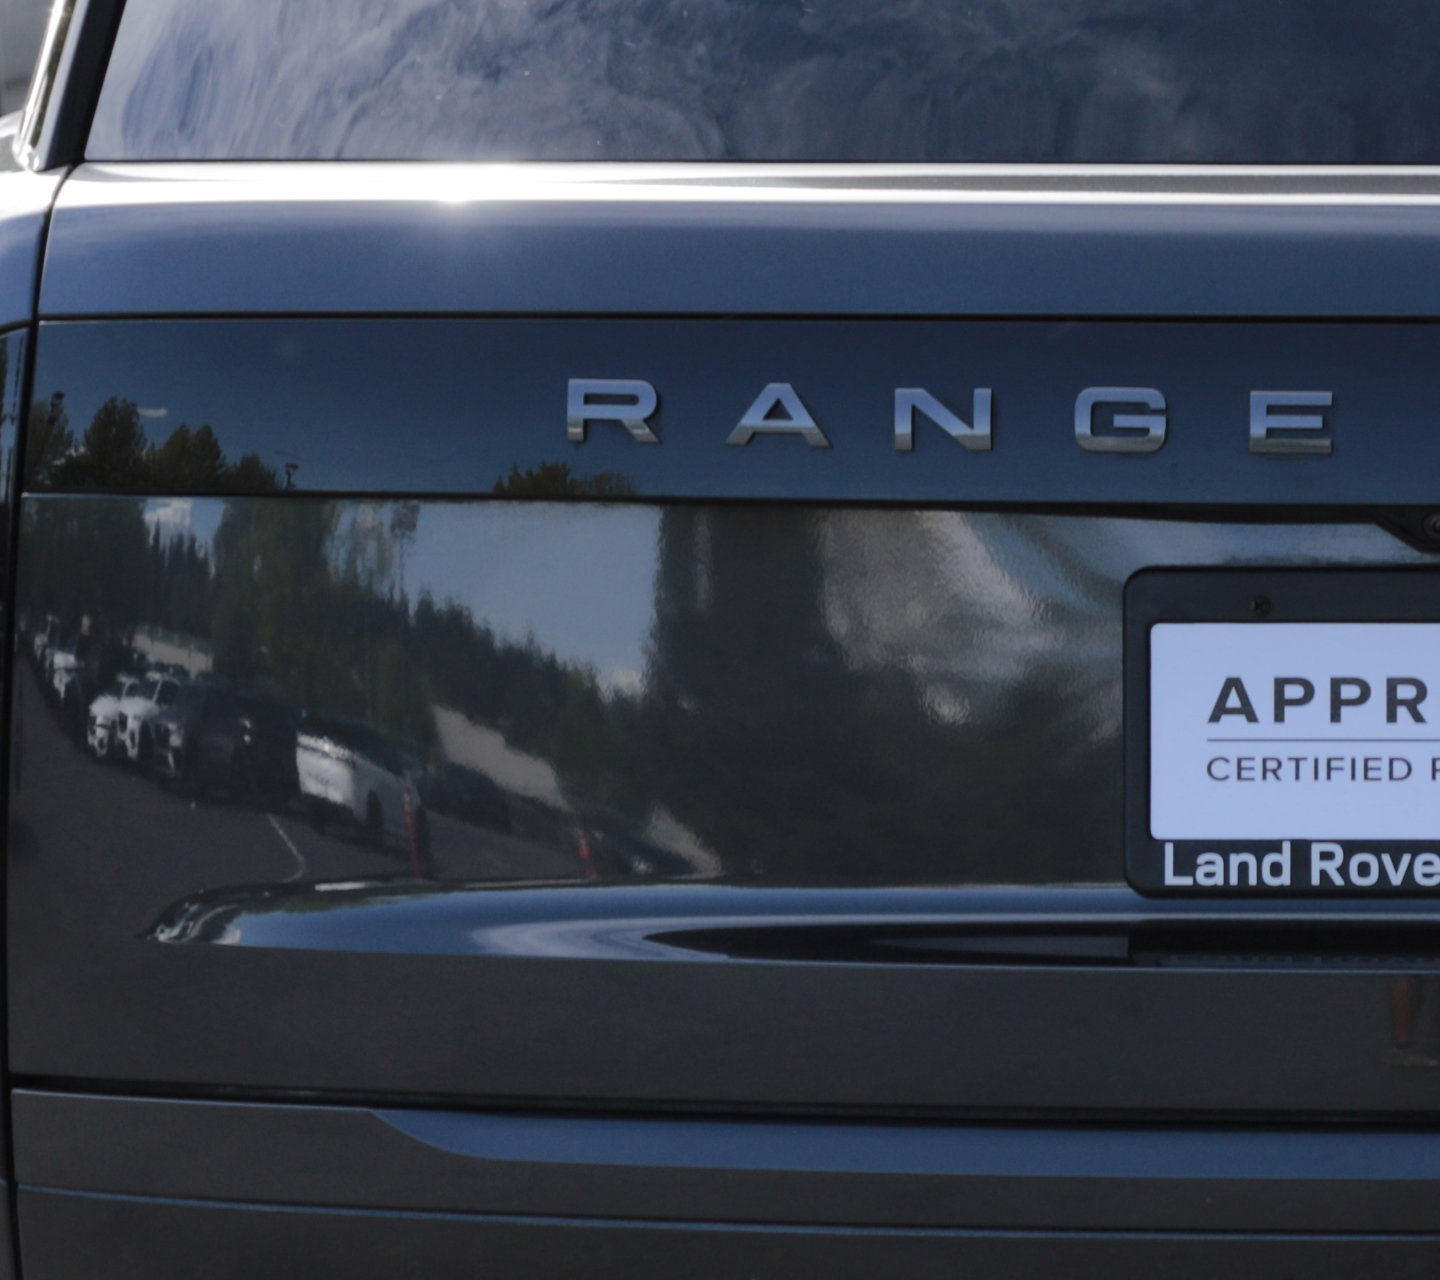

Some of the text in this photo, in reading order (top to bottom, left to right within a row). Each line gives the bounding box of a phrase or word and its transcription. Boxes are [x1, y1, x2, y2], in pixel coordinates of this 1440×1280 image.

[564, 376, 1334, 455] RANGE
[1205, 755, 1414, 783] CERTIFIED
[1163, 840, 1292, 887] Land
